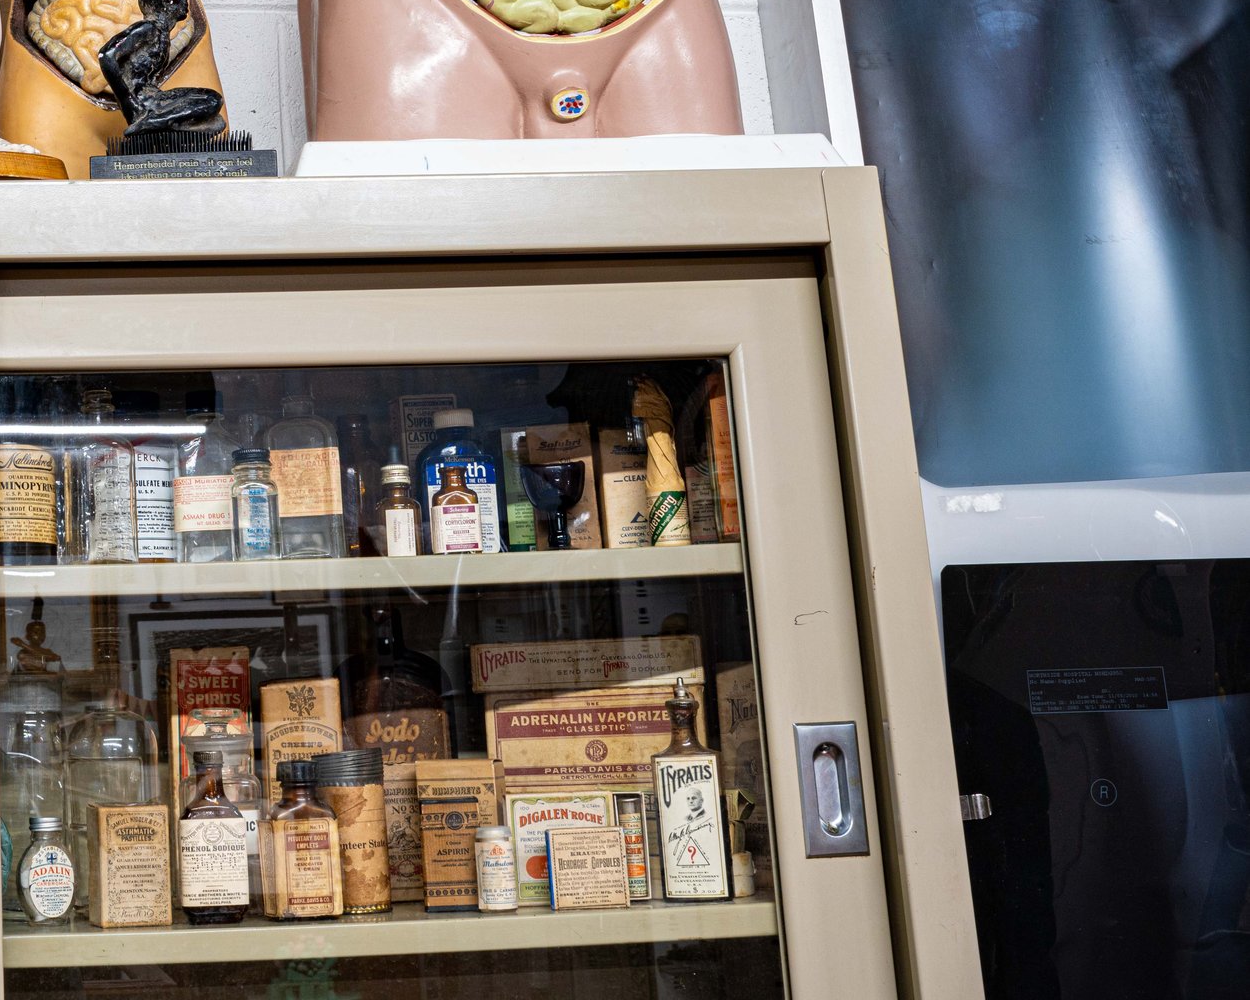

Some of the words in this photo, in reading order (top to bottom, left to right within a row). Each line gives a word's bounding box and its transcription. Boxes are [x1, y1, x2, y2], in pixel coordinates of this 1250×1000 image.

[114, 160, 176, 170] Hemorrhoidal
[178, 160, 199, 168] pain
[208, 159, 214, 167] it
[236, 158, 254, 166] feel
[225, 169, 248, 177] nails
[407, 414, 433, 428] SUPER
[408, 431, 437, 443] CASTO
[182, 513, 205, 521] ASMAN
[631, 665, 672, 673] BOOKLET
[188, 676, 239, 689] SWEET
[186, 693, 241, 706] SPIRITS
[510, 712, 593, 727] ADRENALIN
[589, 765, 623, 773] DAVIS
[432, 786, 481, 795] HUMPHREYS
[1100, 785, 1108, 798] R
[519, 808, 569, 828] DIGALEN
[181, 845, 211, 853] PHENOL
[437, 848, 470, 856] ASPIRIN
[558, 859, 588, 871] HEADACHE
[591, 856, 621, 869] CAPSULES
[32, 864, 71, 878] ADALIN
